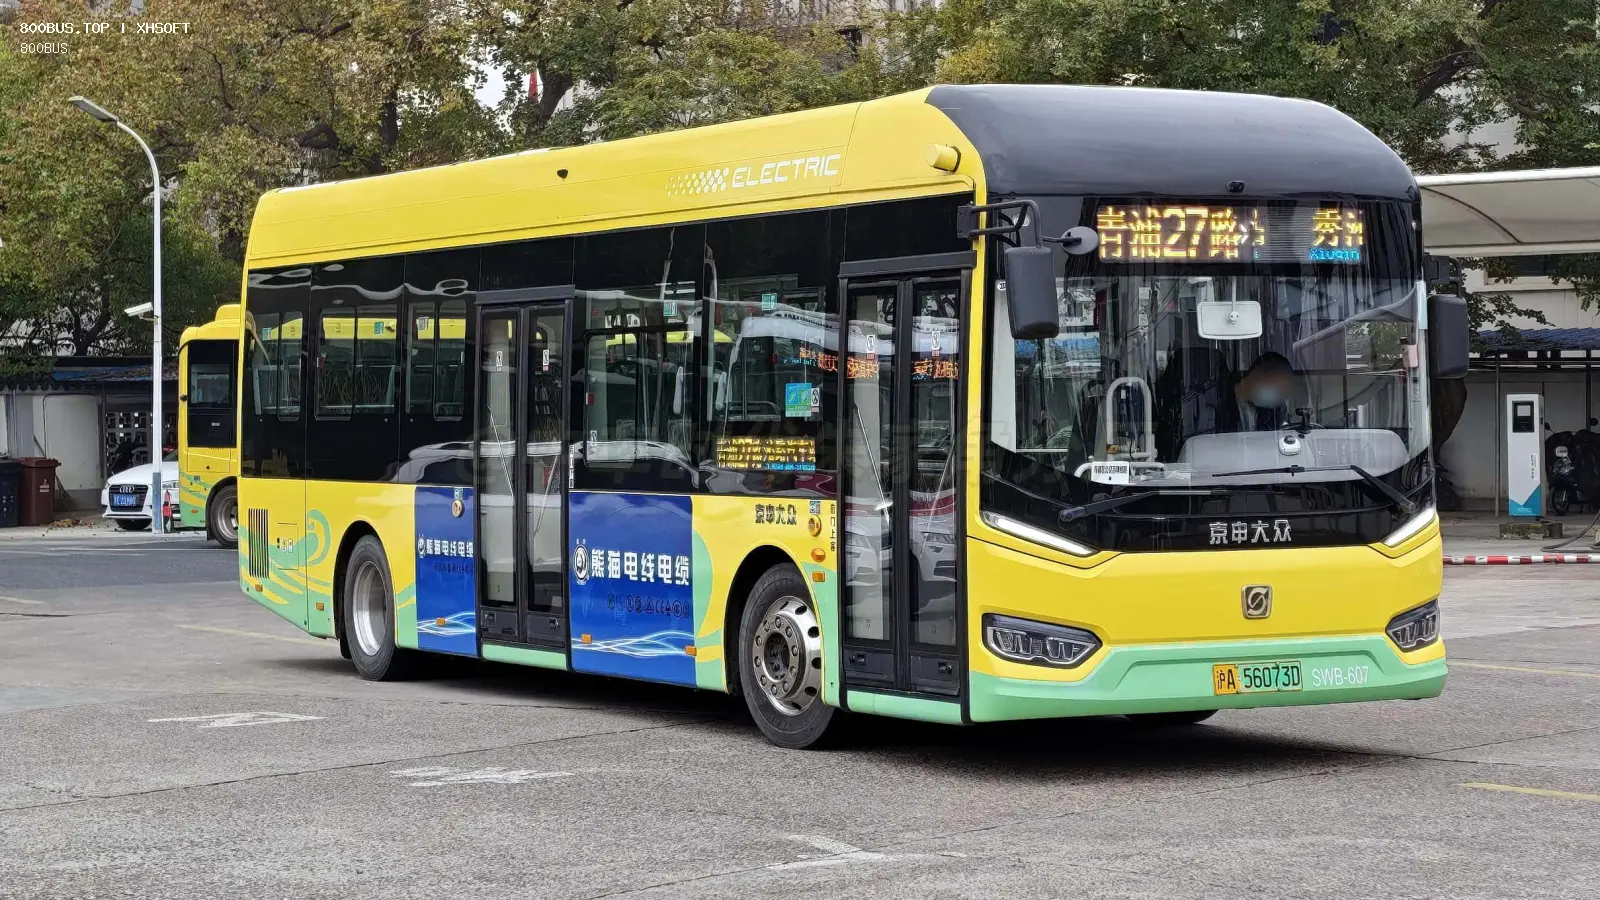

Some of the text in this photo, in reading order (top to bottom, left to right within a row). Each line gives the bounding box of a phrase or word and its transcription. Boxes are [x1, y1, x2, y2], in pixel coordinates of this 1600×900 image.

[731, 154, 841, 189] ELECTRIC
[1097, 206, 1240, 259] 青浦27路
[1209, 519, 1292, 545] 京申大众
[591, 548, 690, 586] 熊猫电线电缆
[1243, 664, 1300, 689] 56073D
[1311, 666, 1369, 687] SWB-607
